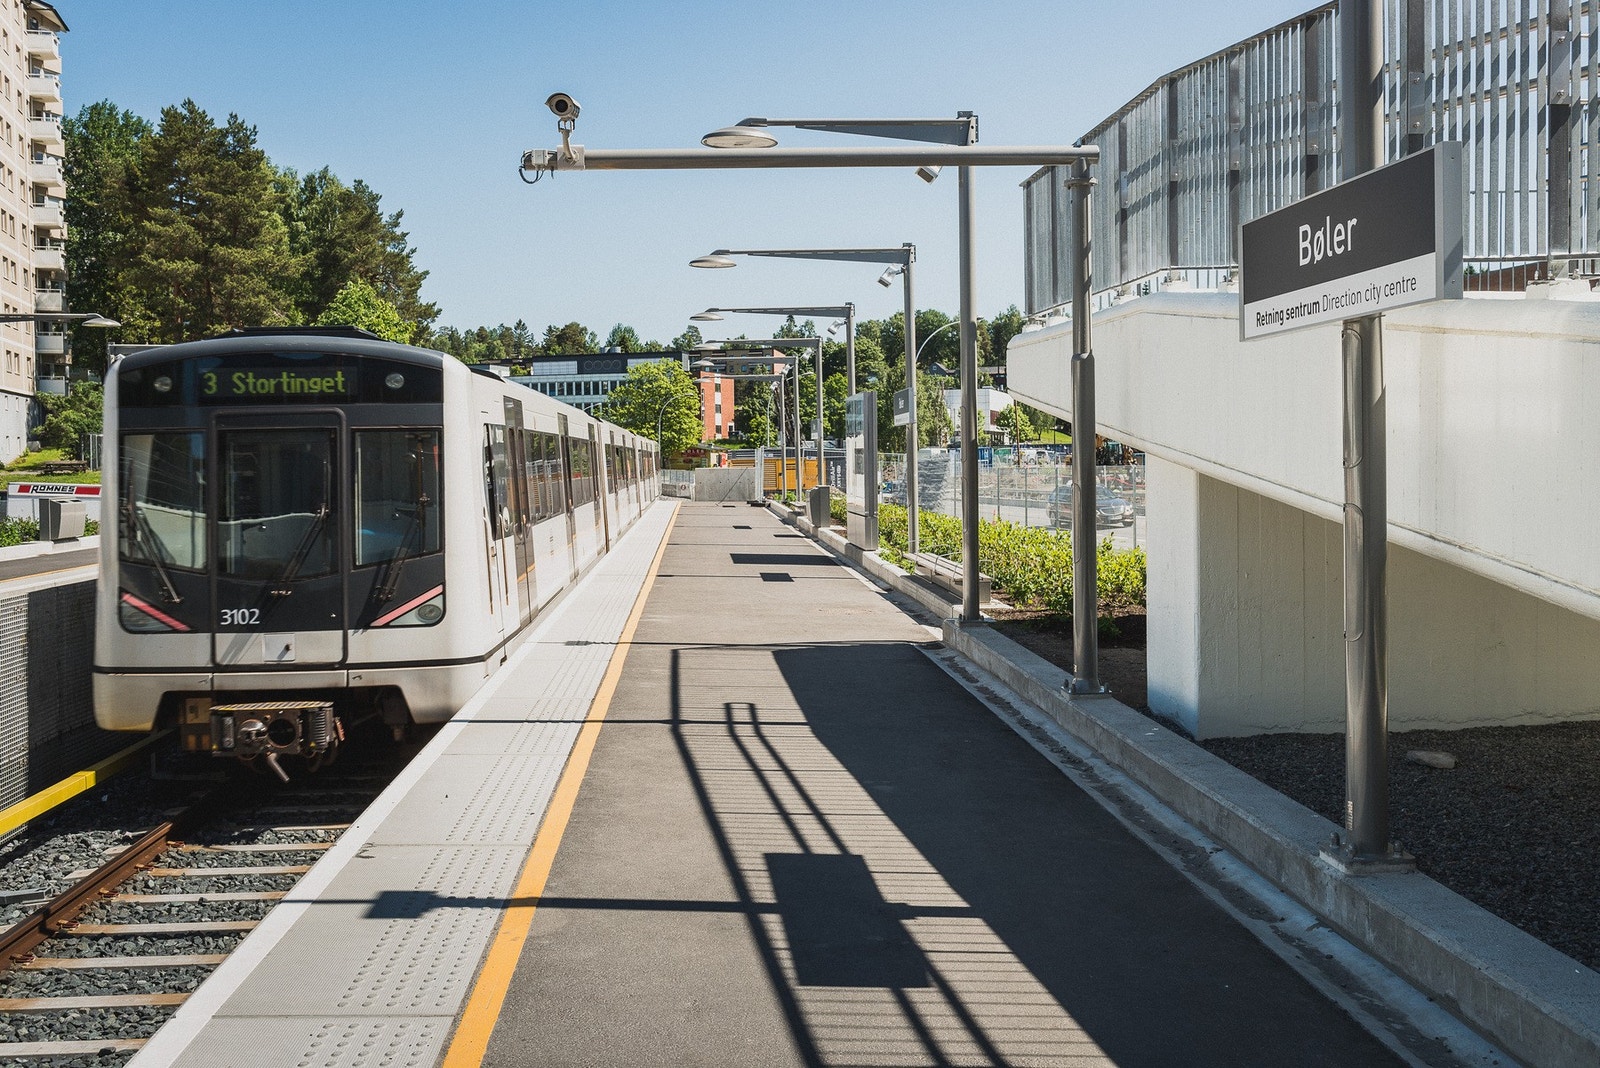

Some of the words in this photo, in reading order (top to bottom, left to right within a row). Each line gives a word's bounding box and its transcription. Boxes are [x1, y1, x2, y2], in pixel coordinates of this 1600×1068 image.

[1299, 216, 1358, 267] Bøler
[1256, 307, 1284, 328] Retning
[1286, 299, 1320, 320] sentrum
[1322, 289, 1362, 312] Direction
[1364, 282, 1382, 304] city
[1384, 276, 1417, 297] centre
[203, 372, 217, 394] 3
[232, 371, 345, 394] Stortinget
[31, 485, 76, 494] ROMNES
[220, 608, 260, 625] 3102
